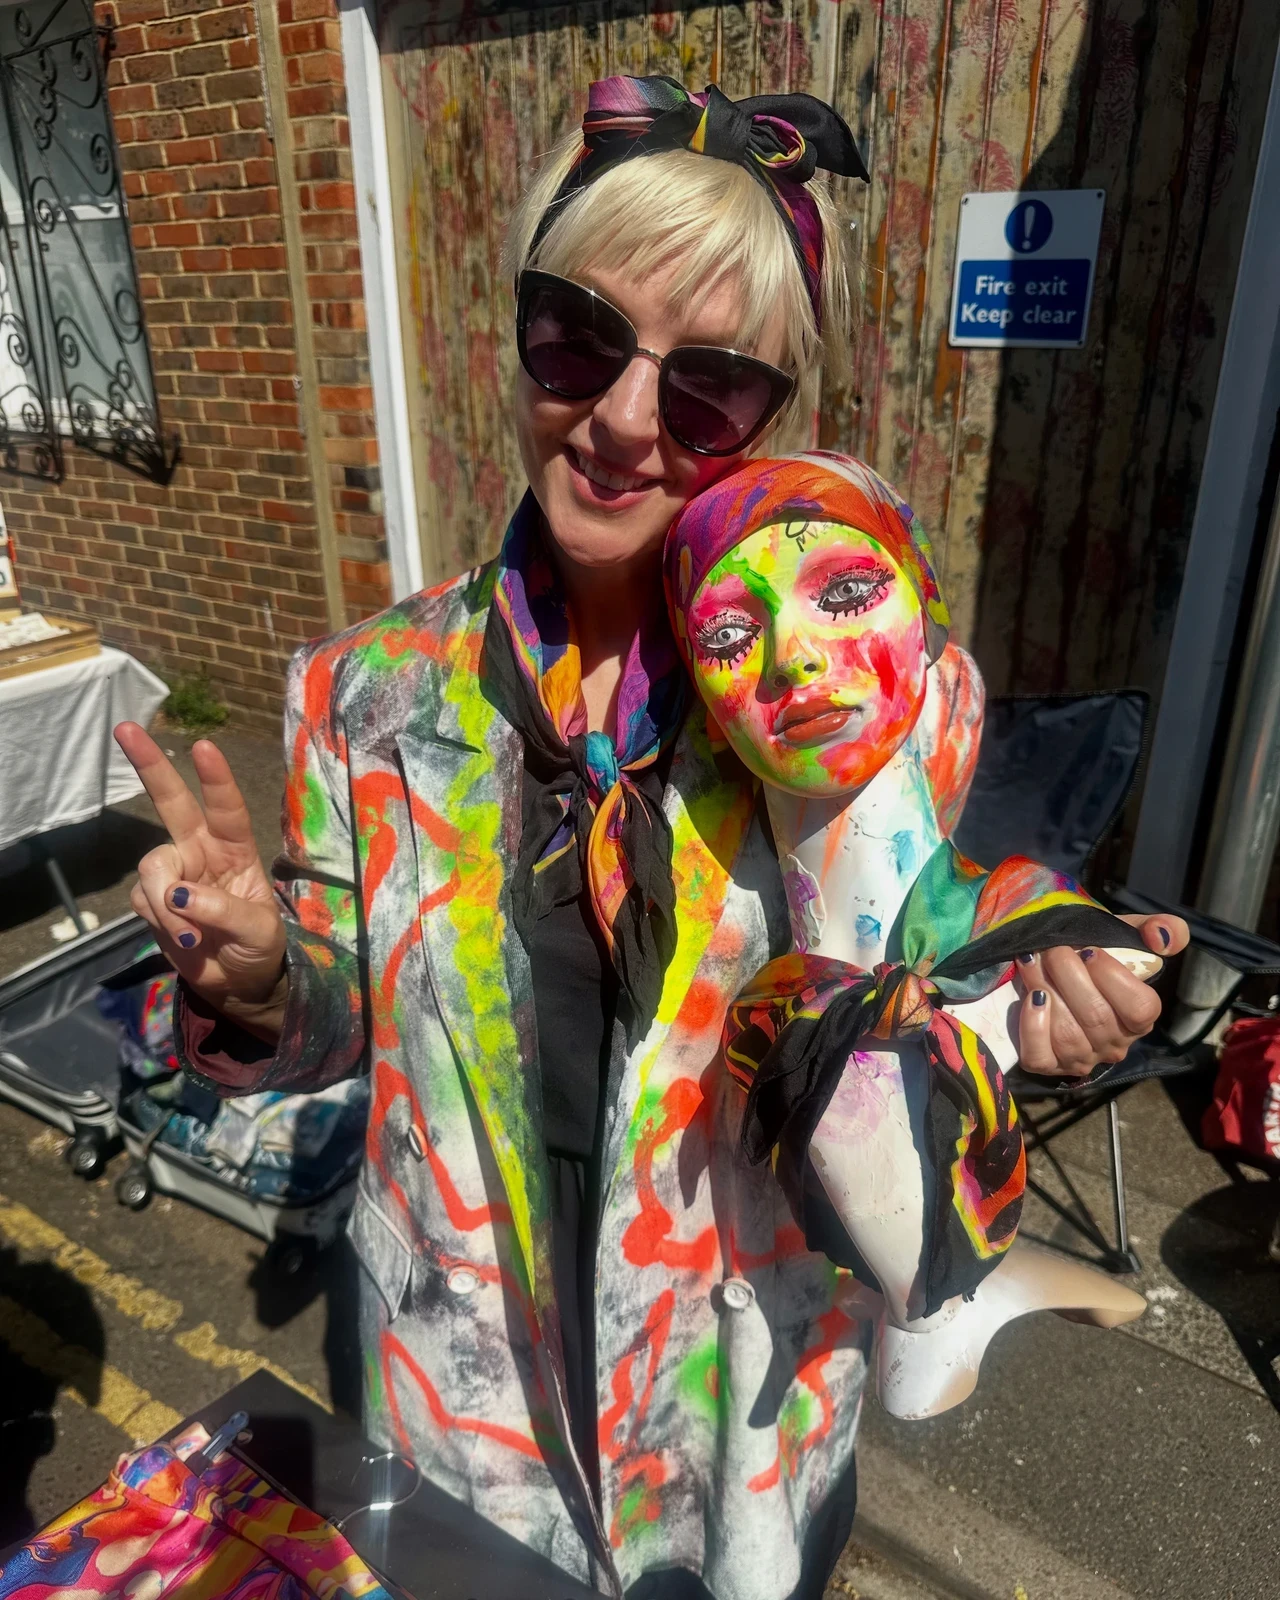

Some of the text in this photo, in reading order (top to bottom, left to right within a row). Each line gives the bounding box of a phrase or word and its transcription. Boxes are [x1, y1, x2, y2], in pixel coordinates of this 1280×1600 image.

[975, 275, 1069, 296] Fire exit
[961, 302, 1077, 329] Keep clear
